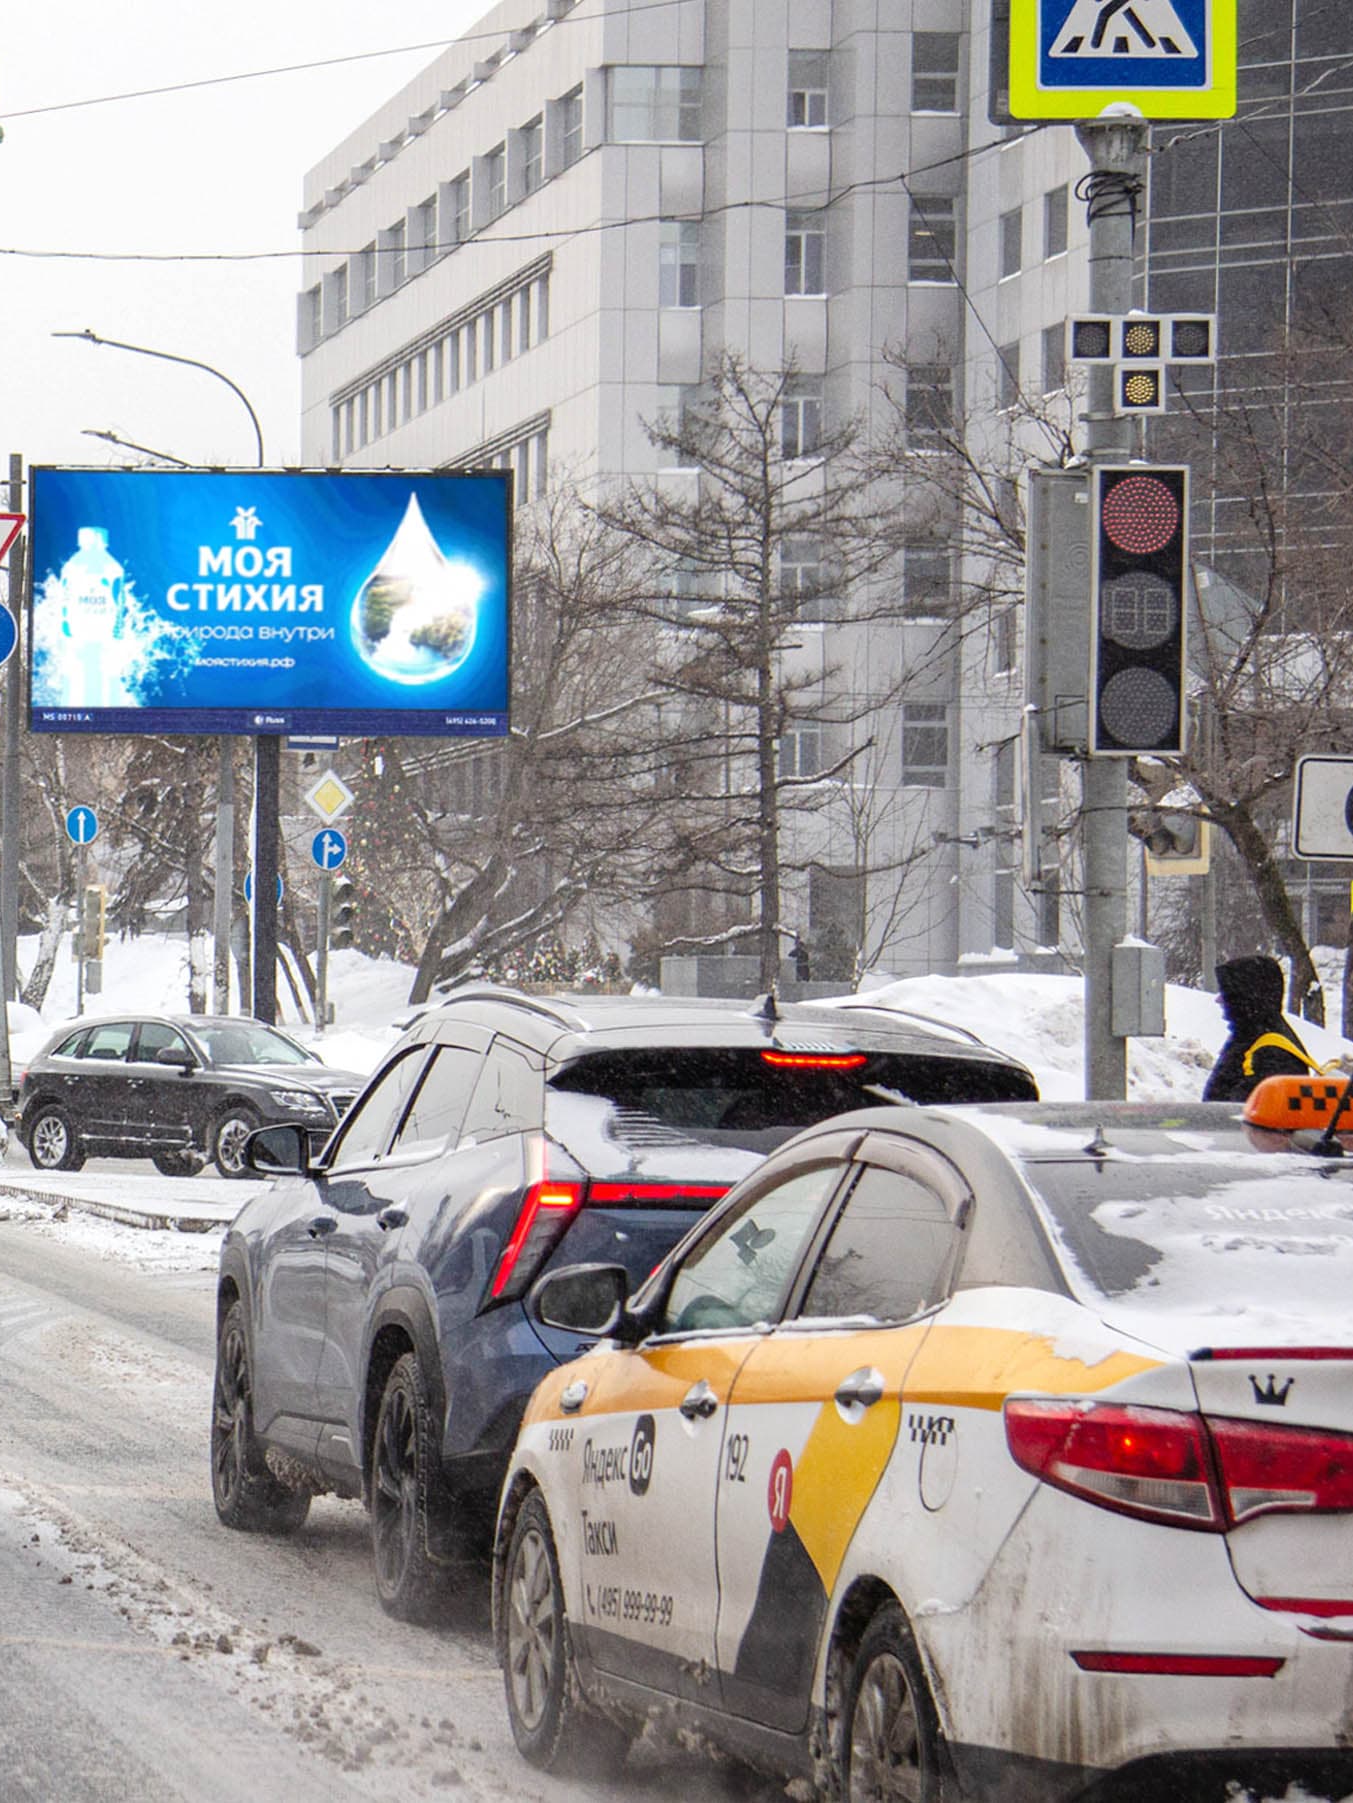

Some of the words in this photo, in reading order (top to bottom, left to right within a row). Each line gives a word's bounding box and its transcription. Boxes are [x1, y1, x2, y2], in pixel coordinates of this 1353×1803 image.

[198, 546, 292, 577] МОЯ
[166, 582, 324, 612] СТИХИЯ
[159, 626, 253, 642] рирода
[259, 626, 335, 643] внутри
[583, 1438, 628, 1489] Яндекс
[631, 1431, 652, 1480] Go
[725, 1434, 749, 1482] 192
[582, 1510, 619, 1556] Такси
[597, 1584, 622, 1622] (495)
[623, 1589, 674, 1626] 999-99-99
